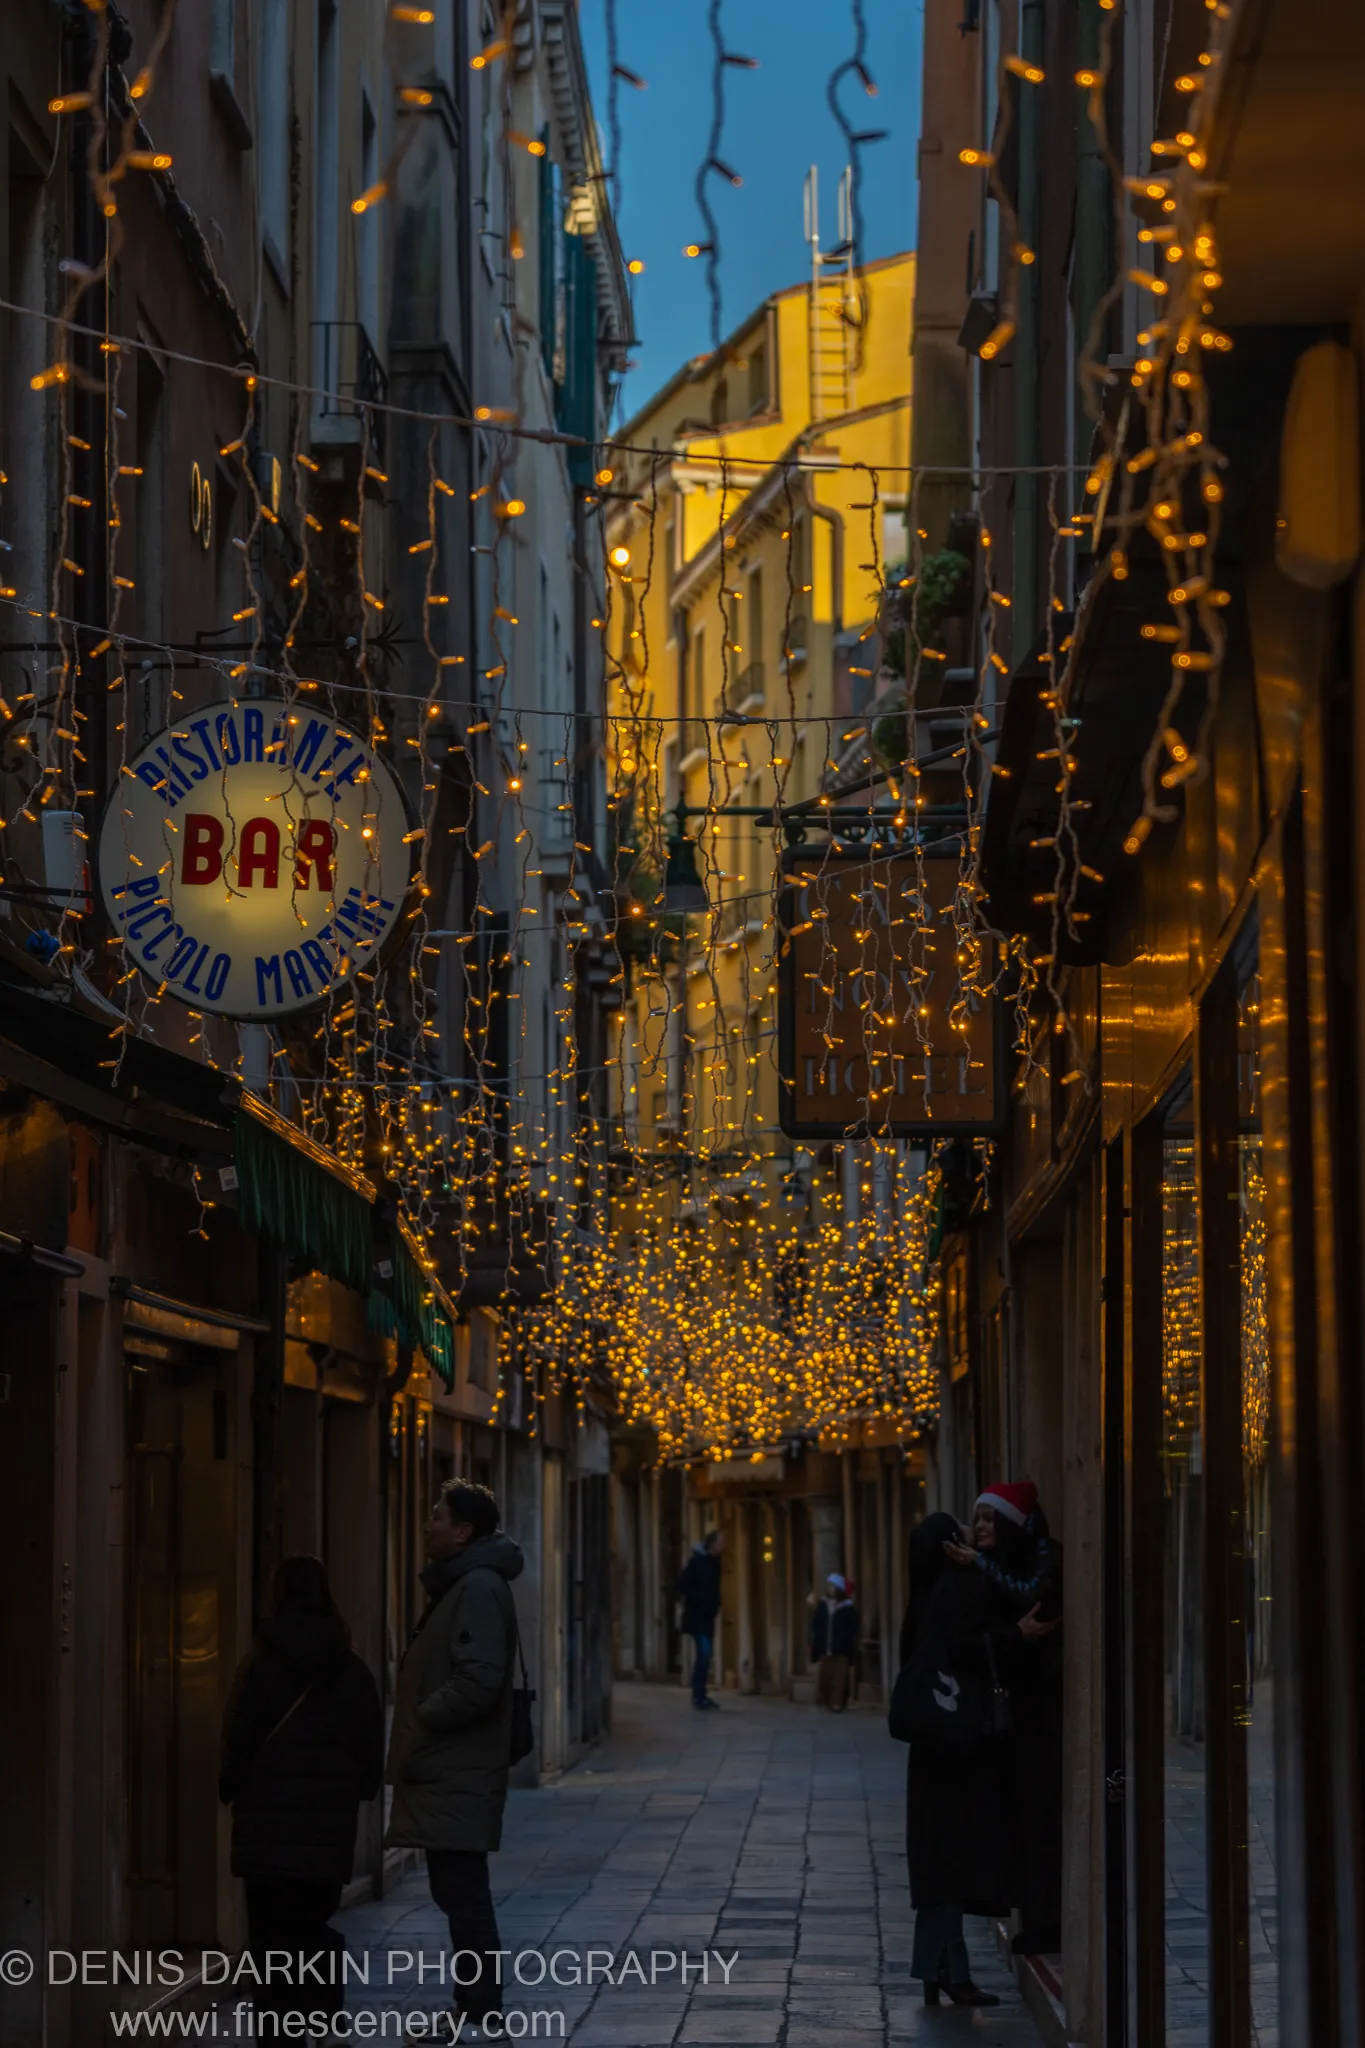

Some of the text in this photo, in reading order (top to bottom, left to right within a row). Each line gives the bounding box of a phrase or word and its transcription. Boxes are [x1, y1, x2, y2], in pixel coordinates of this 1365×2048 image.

[136, 708, 372, 807] RISTORANTE
[181, 813, 338, 892] BAR
[111, 875, 395, 1006] PICCOLO MARTINI
[802, 1054, 987, 1097] HOTEL
